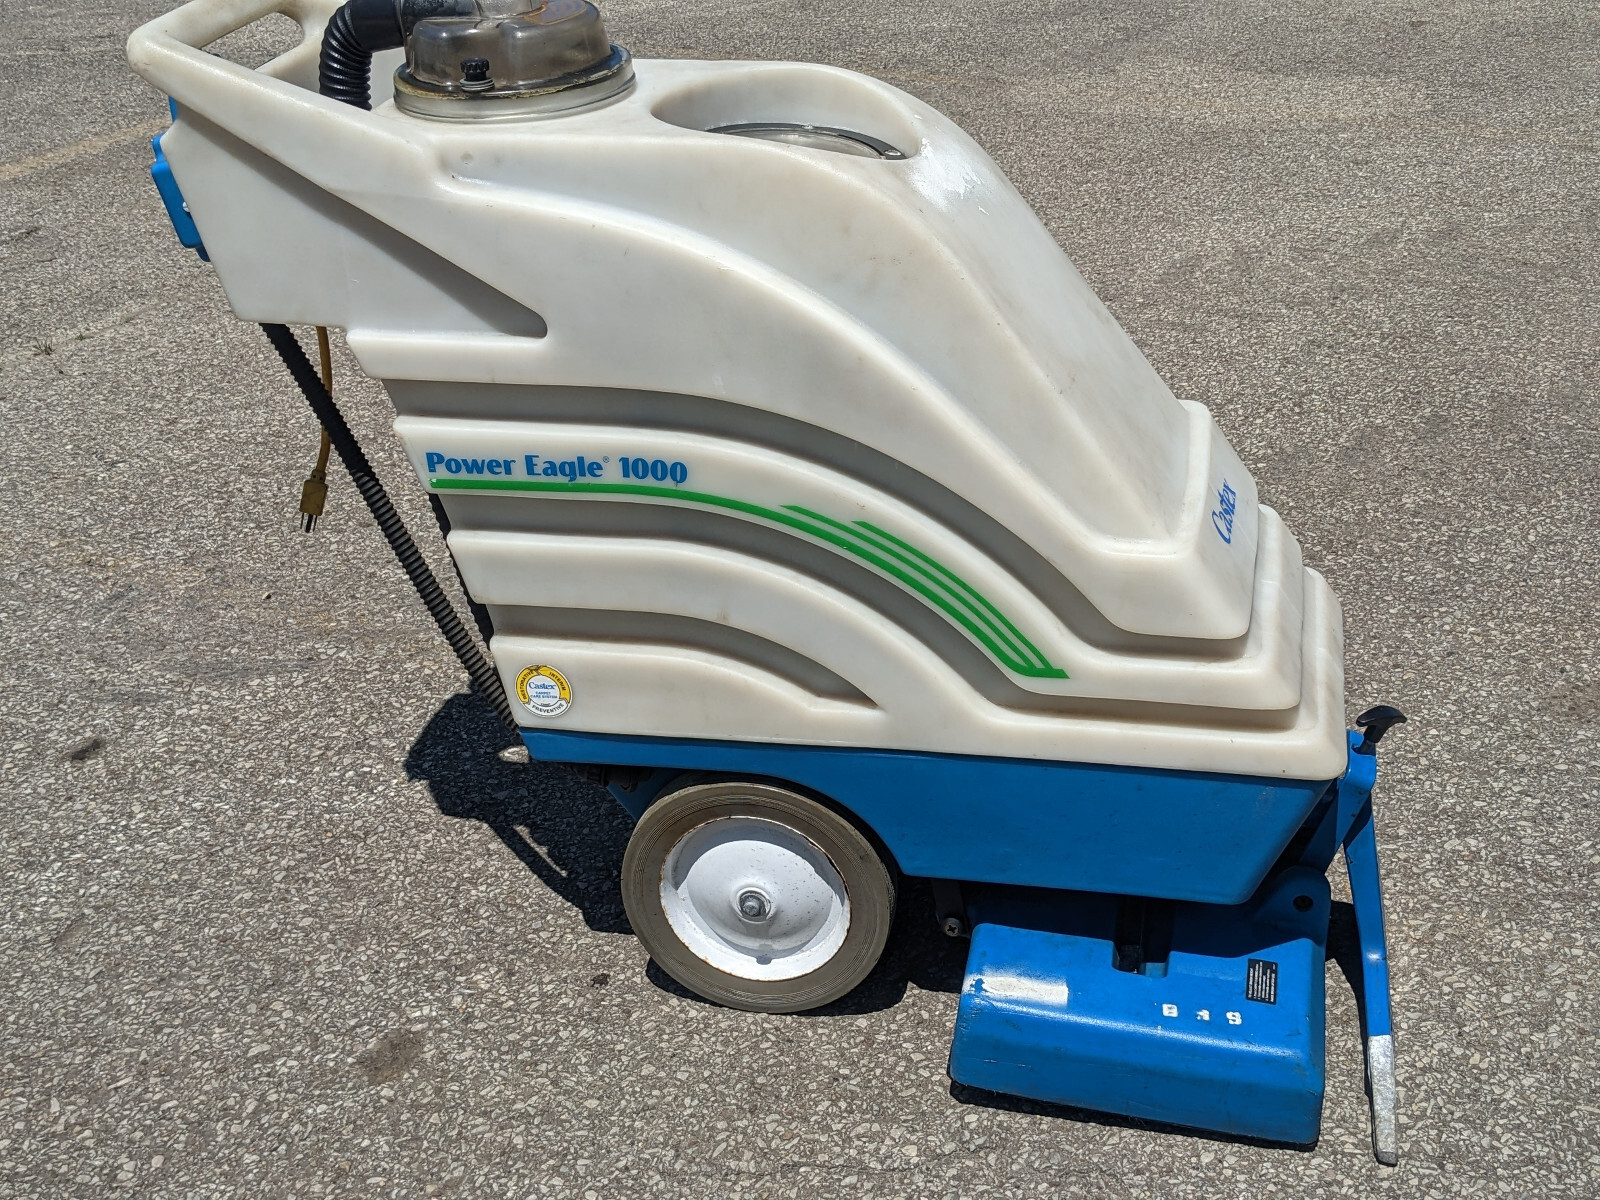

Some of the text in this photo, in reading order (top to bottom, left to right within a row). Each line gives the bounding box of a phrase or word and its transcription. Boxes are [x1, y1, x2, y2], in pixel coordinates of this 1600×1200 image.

[426, 452, 516, 476] Power
[619, 457, 688, 484] 1000
[1212, 478, 1236, 545] Castex
[549, 672, 566, 690] INTERIM
[532, 703, 564, 714] PREVENTIVE
